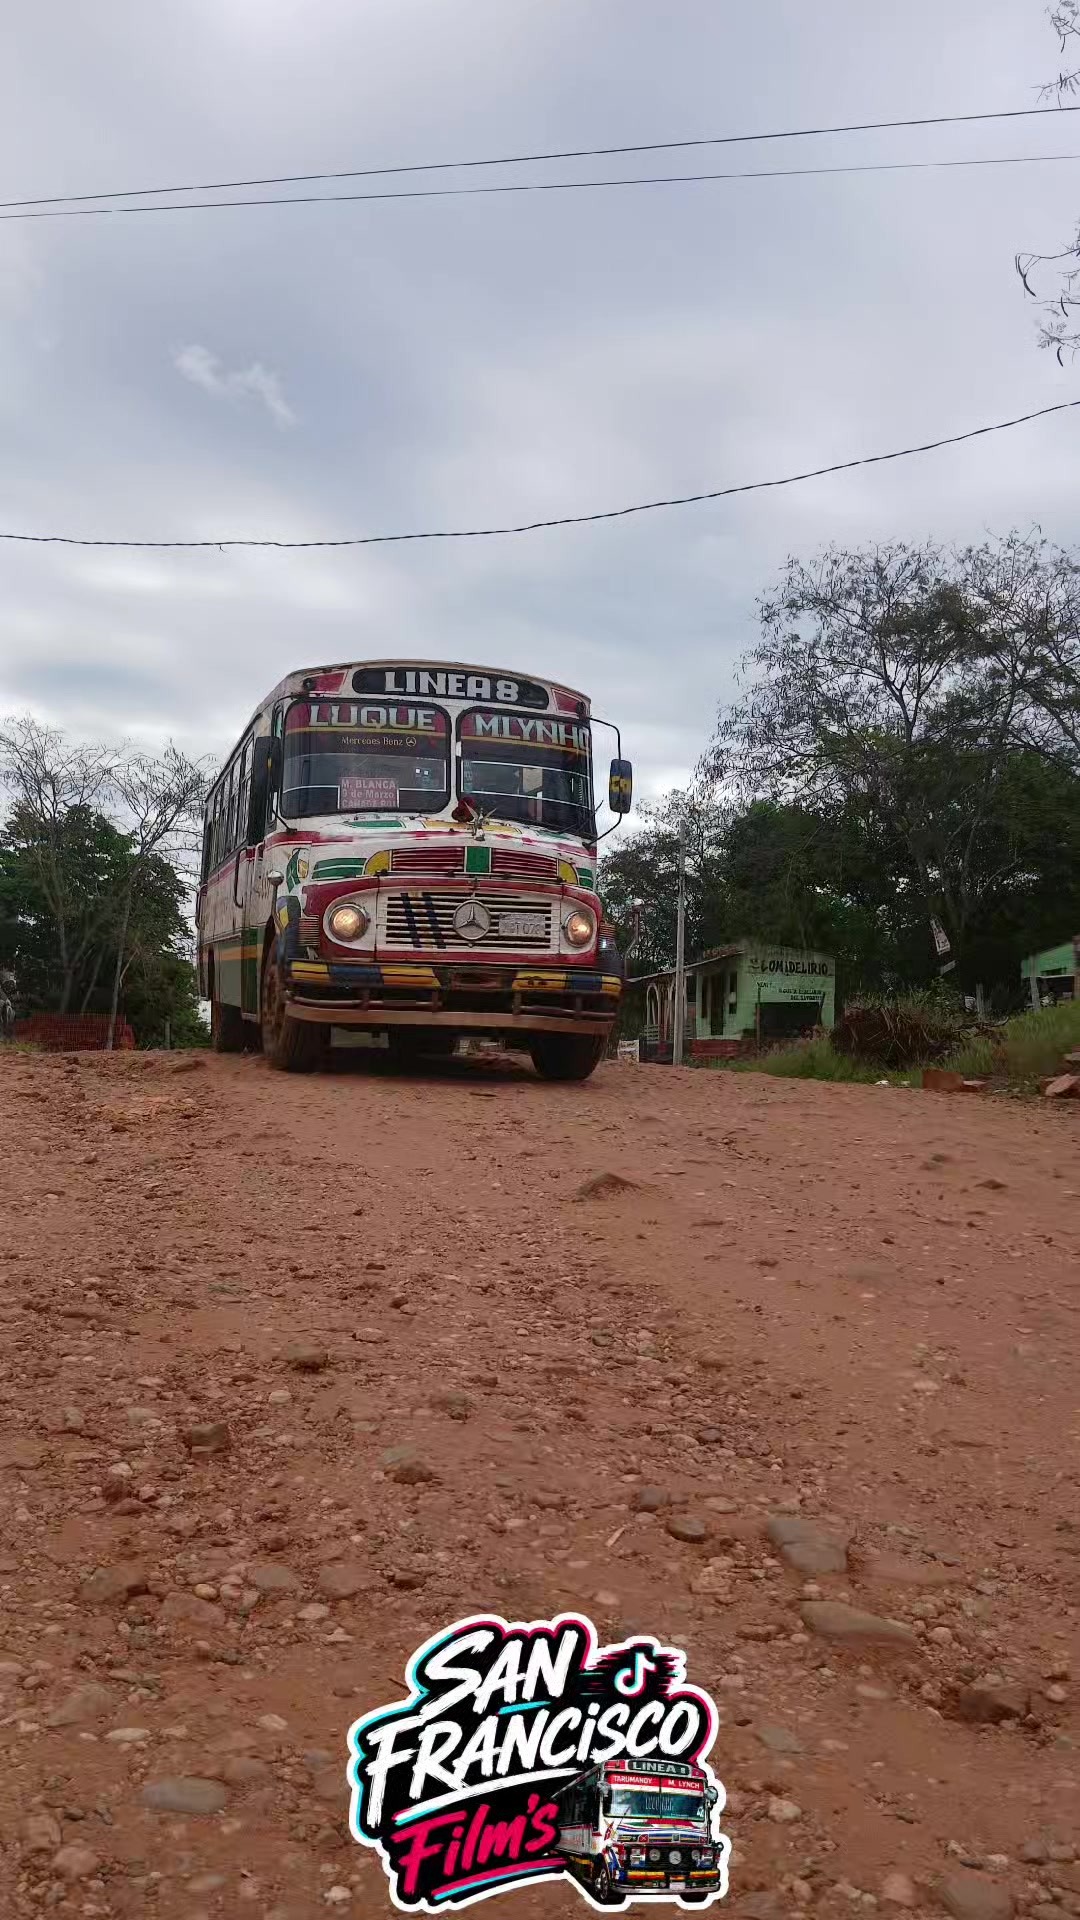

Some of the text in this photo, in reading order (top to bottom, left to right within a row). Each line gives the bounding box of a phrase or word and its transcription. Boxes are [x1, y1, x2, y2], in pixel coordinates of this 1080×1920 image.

[384, 671, 519, 702] LINEA 8
[308, 705, 436, 731] LUQUE
[350, 788, 363, 798] de
